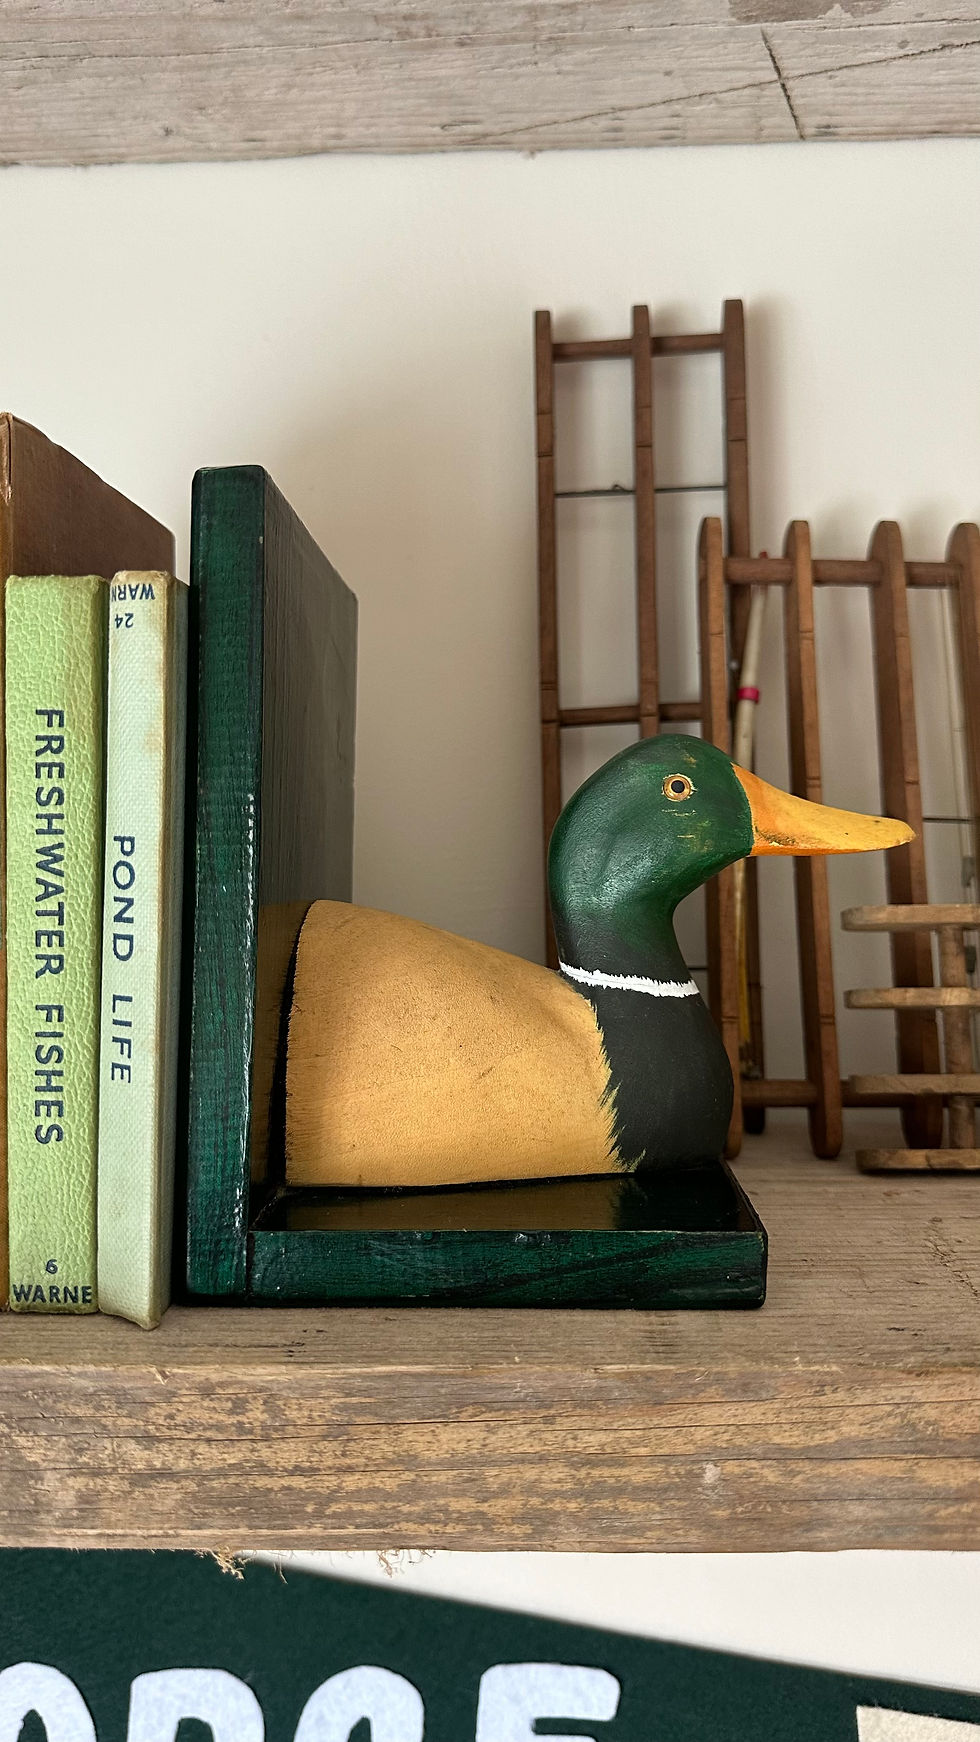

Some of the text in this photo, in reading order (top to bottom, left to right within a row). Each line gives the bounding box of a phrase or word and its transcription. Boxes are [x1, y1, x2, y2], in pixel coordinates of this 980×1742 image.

[114, 612, 134, 629] 24
[34, 709, 65, 1145] FRESHWATER FISHES
[110, 835, 136, 1084] POND LIFE
[45, 1258, 58, 1275] 6
[12, 1284, 93, 1304] WARNE
